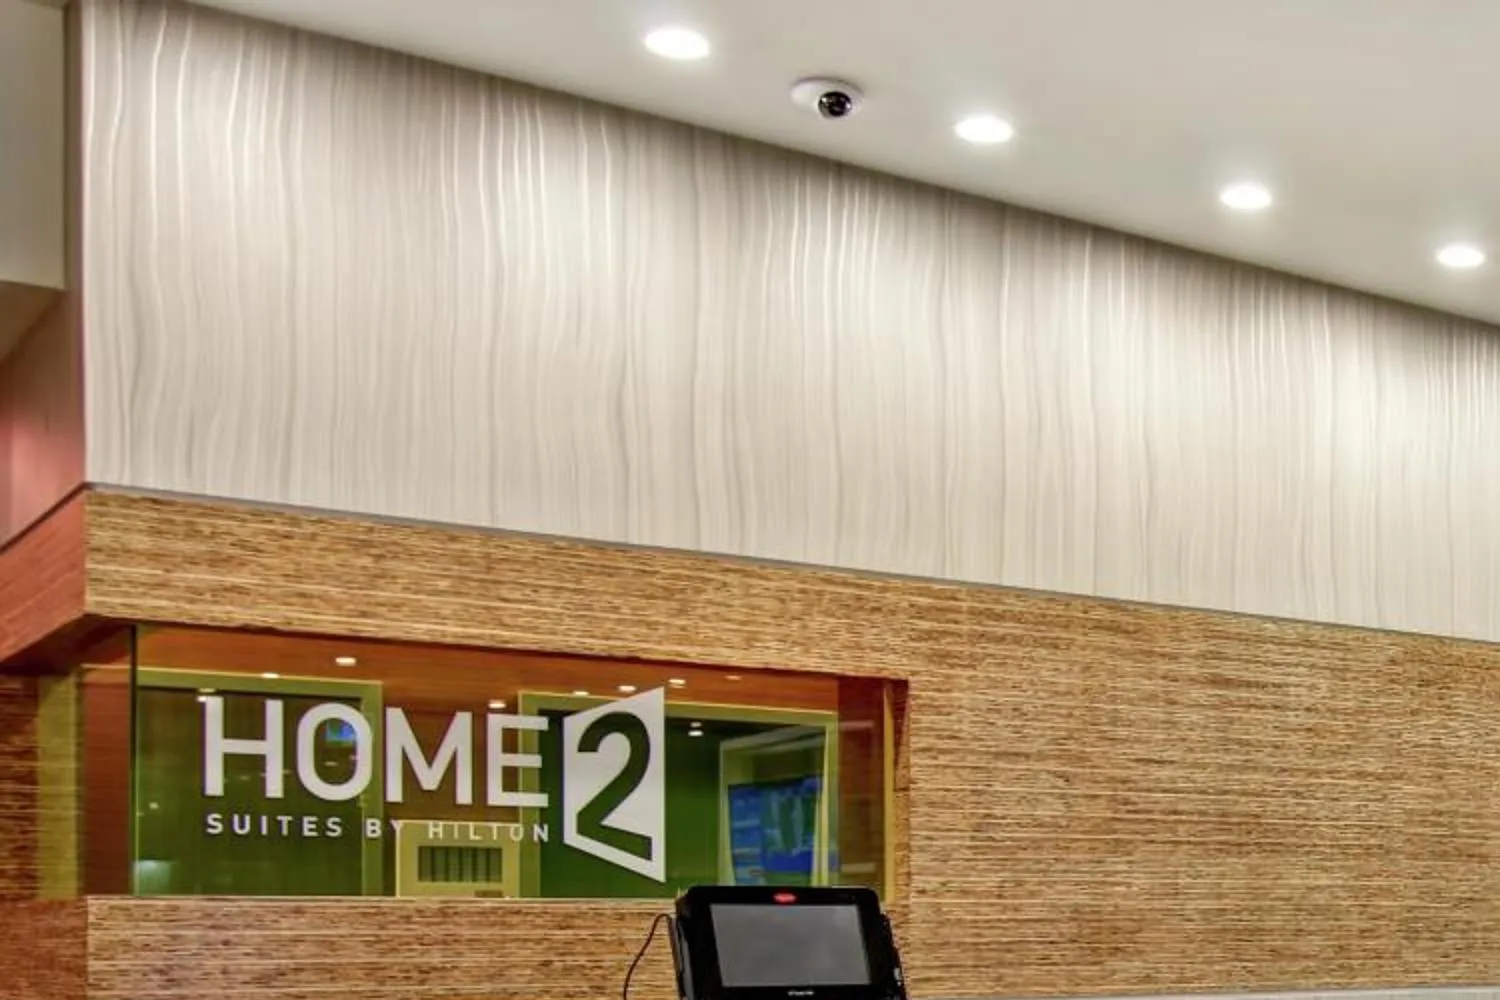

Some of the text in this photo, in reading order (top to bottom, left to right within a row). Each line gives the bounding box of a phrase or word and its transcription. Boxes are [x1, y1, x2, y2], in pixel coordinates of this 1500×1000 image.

[204, 696, 653, 863] HOME 2
[205, 813, 549, 843] SUITES BY HILTON
